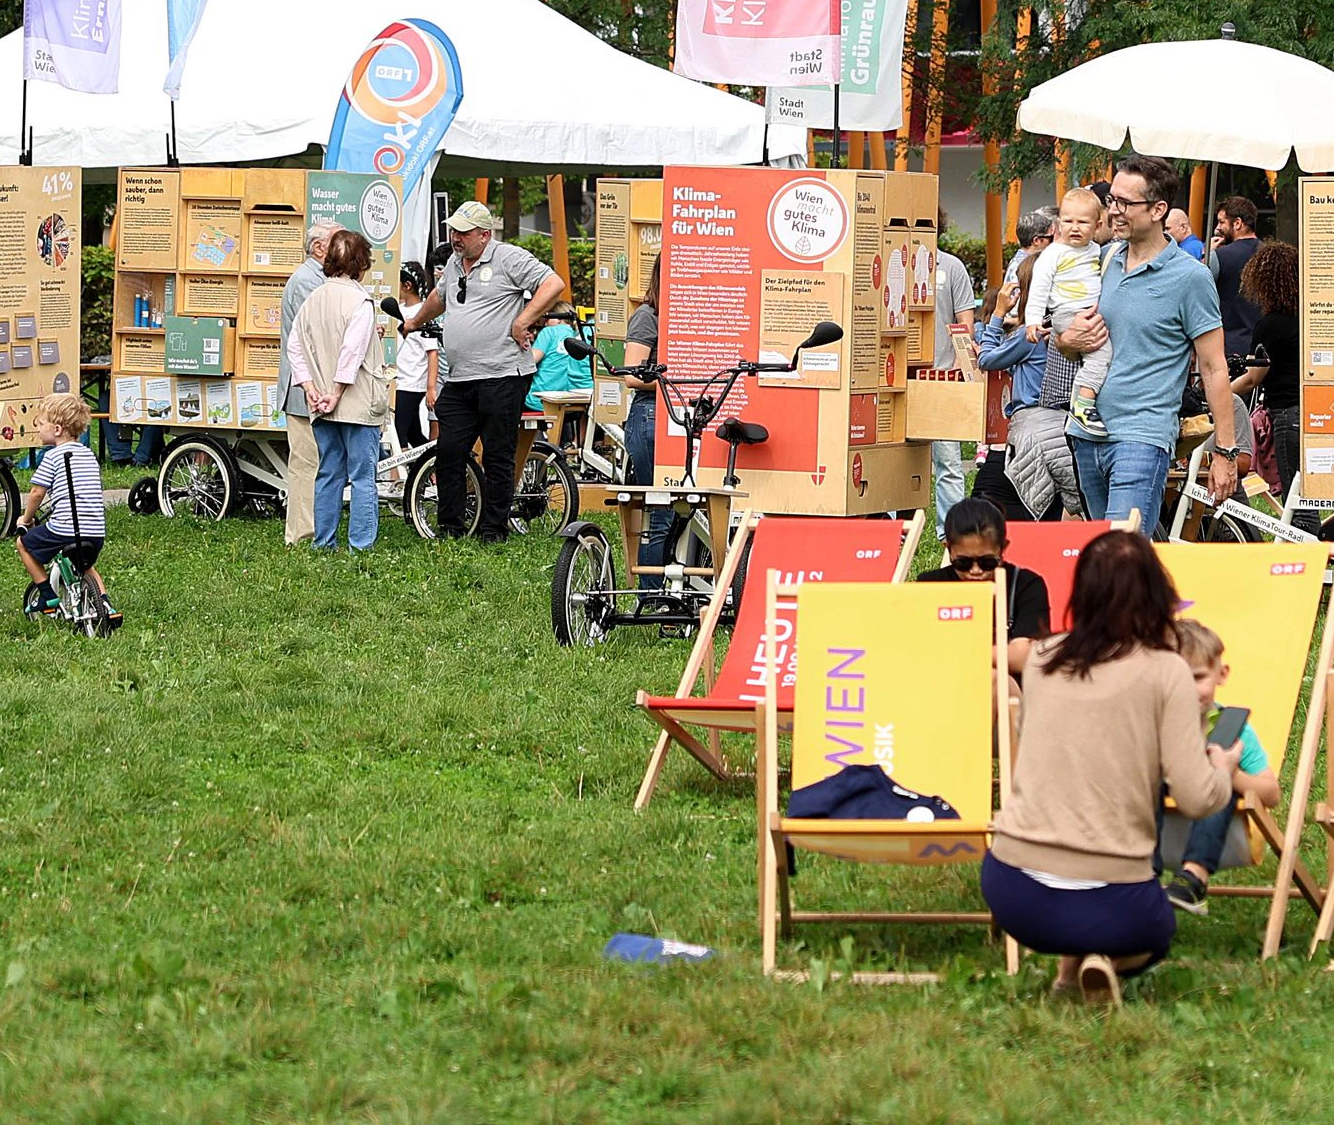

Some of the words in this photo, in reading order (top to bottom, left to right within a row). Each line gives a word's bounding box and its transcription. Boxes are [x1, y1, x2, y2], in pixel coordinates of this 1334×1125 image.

[35, 49, 54, 62] Sta
[34, 61, 56, 74] Wie
[779, 97, 804, 109] Stadt
[779, 107, 804, 118] Wien
[42, 172, 73, 195] 41%
[125, 186, 147, 194] sauber,
[312, 188, 339, 199] Wasser
[373, 189, 387, 200] Wien
[673, 187, 721, 201] Klima-
[125, 195, 145, 204] richtig
[795, 189, 823, 204] Wien
[1309, 195, 1325, 204] Bau
[312, 201, 335, 211] macht
[336, 203, 356, 214] gutes
[367, 203, 384, 214] gutes
[672, 204, 736, 221] Fahrplan
[796, 202, 834, 217] macht
[371, 214, 388, 225] Klima
[784, 208, 817, 223] gutes
[671, 221, 693, 235] für
[696, 222, 734, 236] Wien
[791, 221, 826, 238] Klima
[1191, 489, 1202, 498] Ich
[1226, 502, 1251, 519] Wiener
[856, 550, 881, 559] ORF
[1271, 564, 1304, 574] ORF
[809, 571, 823, 580] 2
[939, 608, 972, 619] ORF
